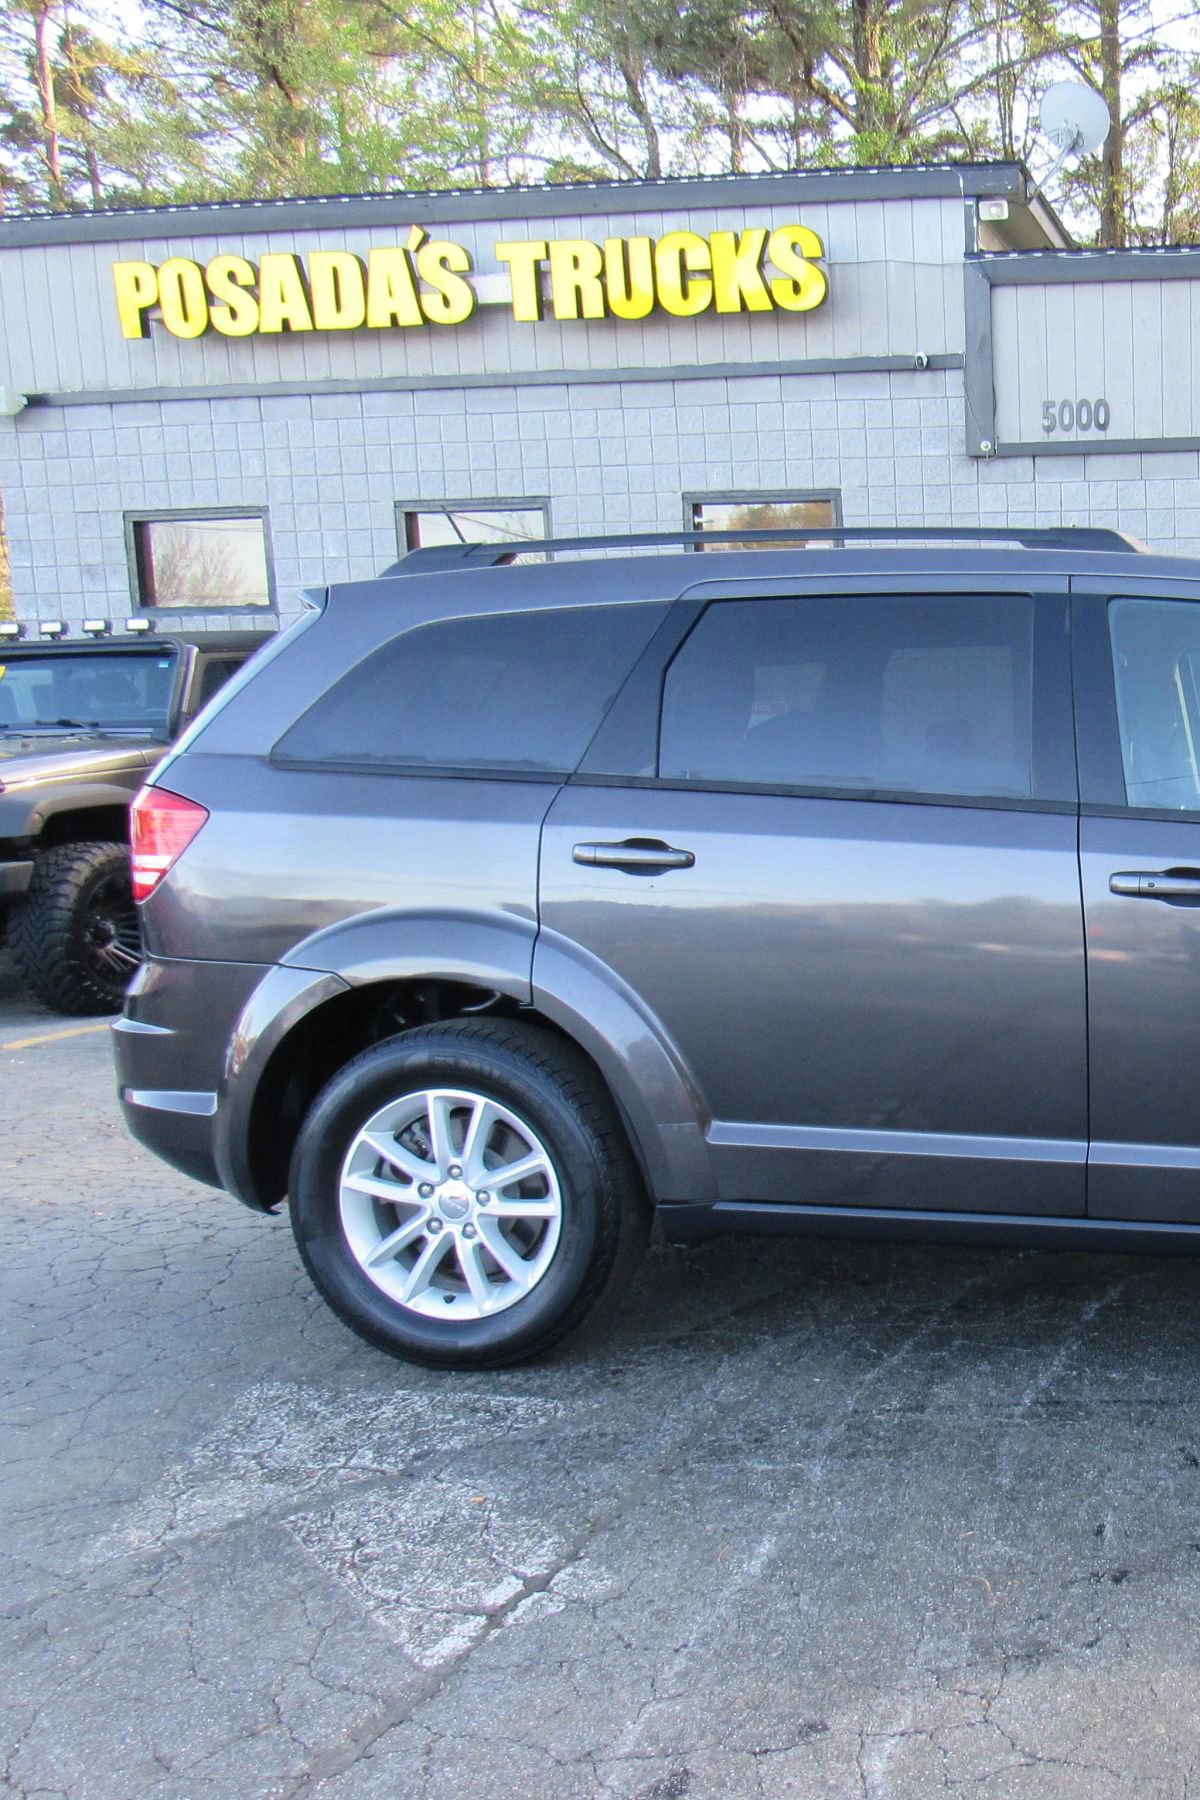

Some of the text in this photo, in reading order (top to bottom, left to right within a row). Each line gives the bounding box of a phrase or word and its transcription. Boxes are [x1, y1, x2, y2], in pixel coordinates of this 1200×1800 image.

[113, 224, 829, 339] POSADA'S TRUCKS
[1041, 398, 1110, 433] 5000
